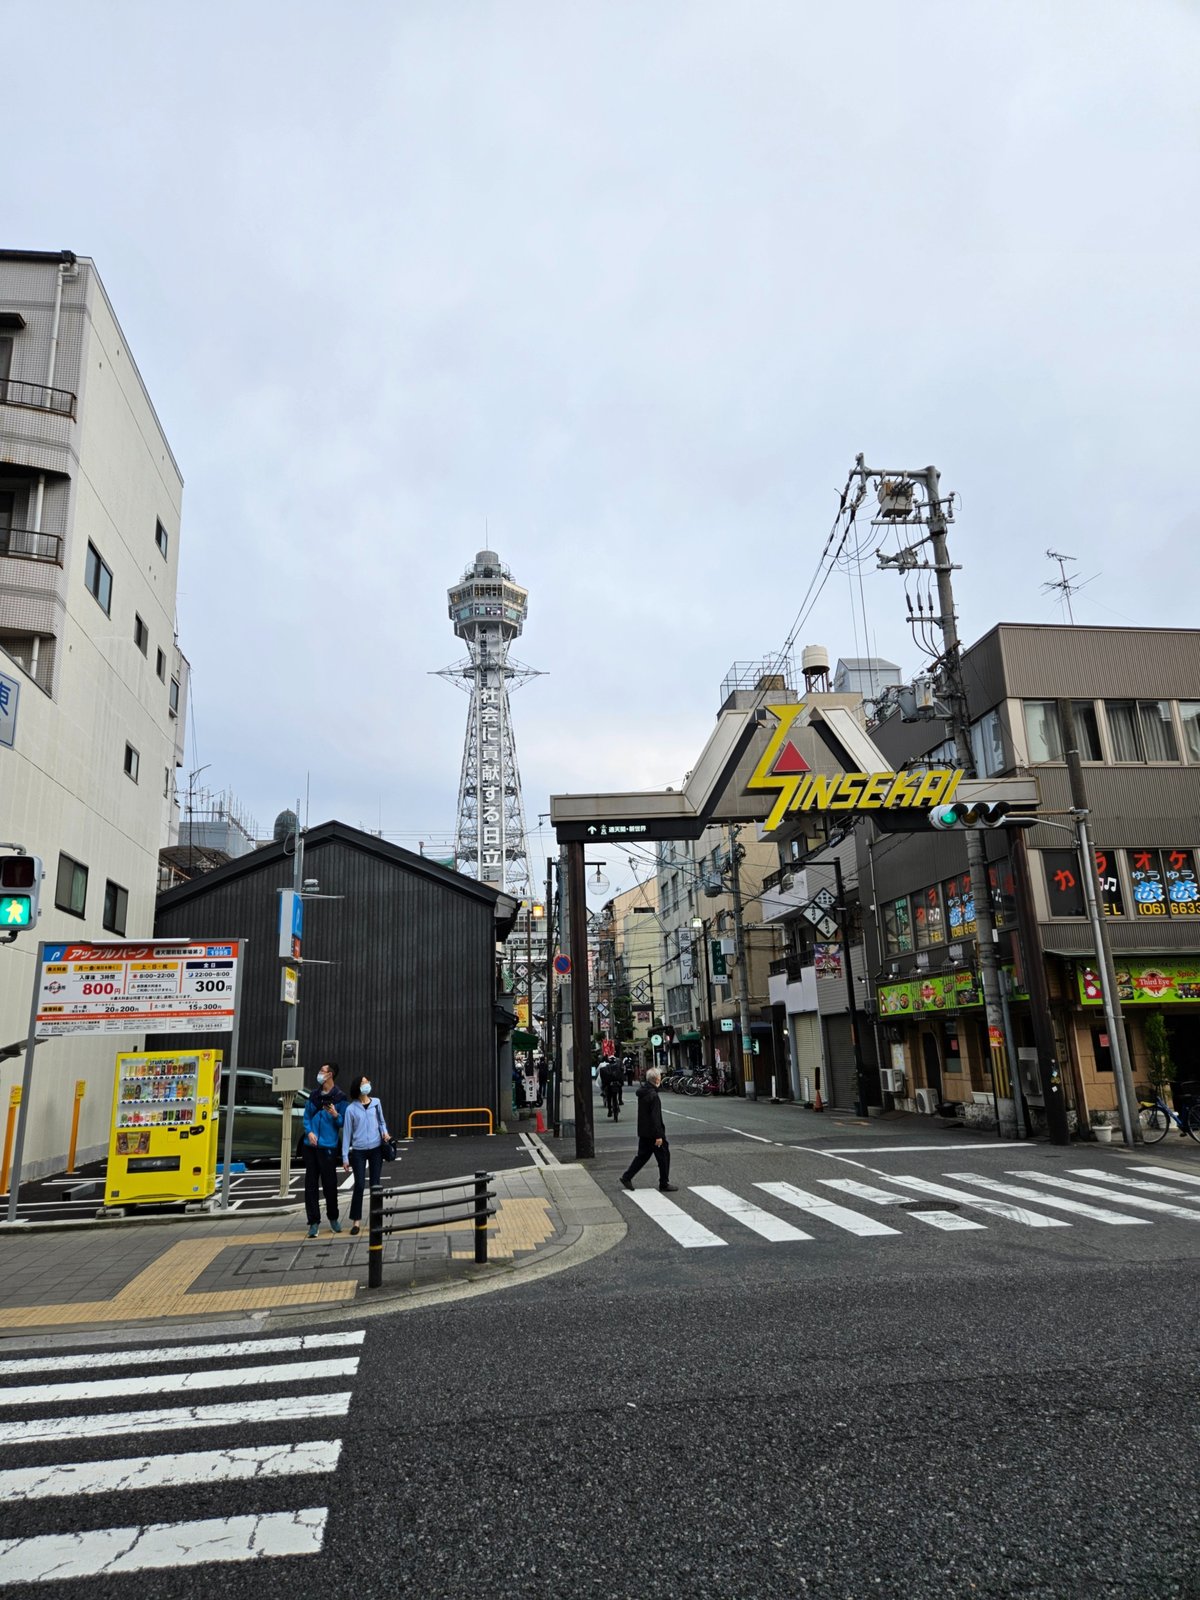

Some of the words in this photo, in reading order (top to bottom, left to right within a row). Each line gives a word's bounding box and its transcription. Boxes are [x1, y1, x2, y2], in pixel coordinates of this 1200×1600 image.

[481, 688, 502, 868] 社会に貢献する日立
[1104, 904, 1121, 916] EL
[1139, 903, 1166, 915] (06)
[68, 948, 149, 960] アップルパーク
[1138, 978, 1158, 986] Third
[1158, 979, 1171, 987] Eye
